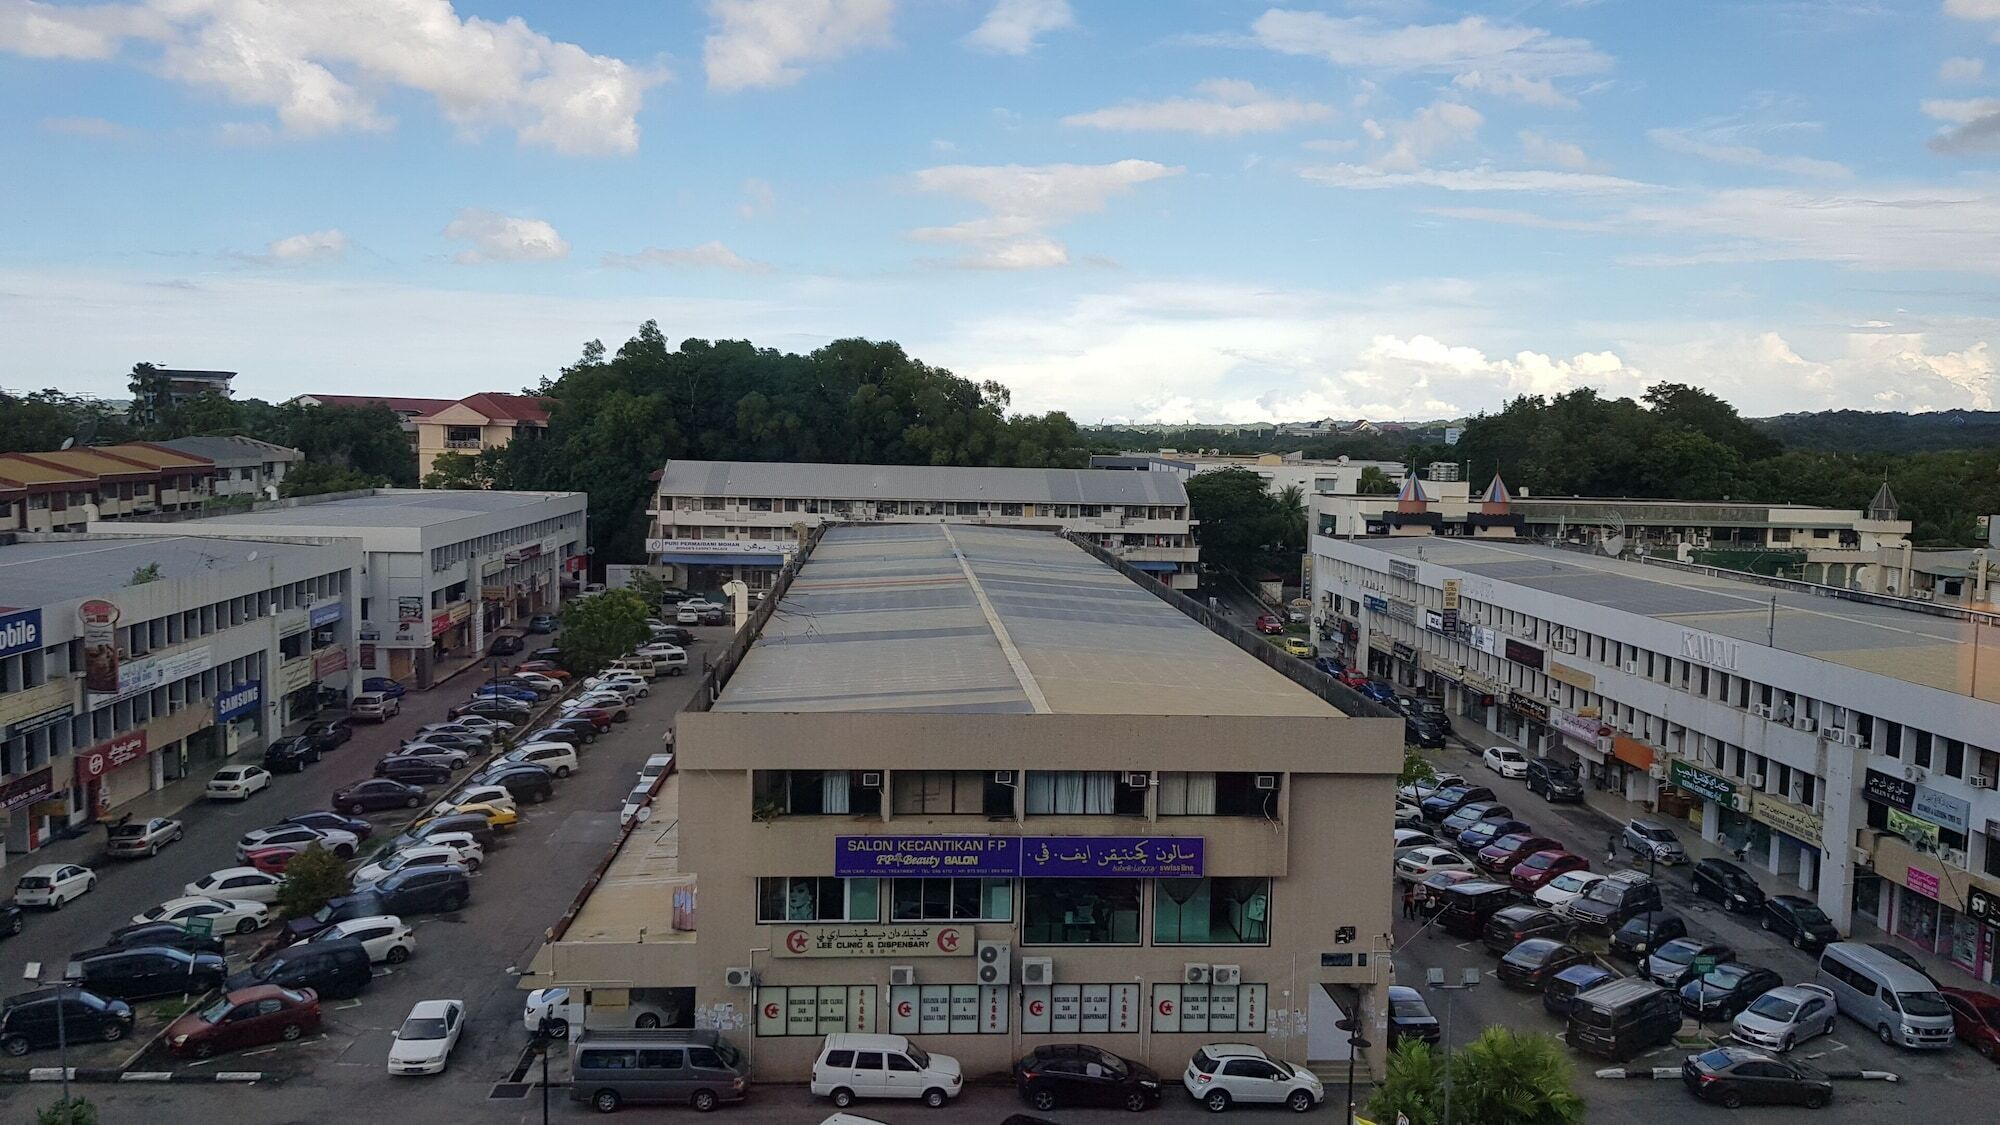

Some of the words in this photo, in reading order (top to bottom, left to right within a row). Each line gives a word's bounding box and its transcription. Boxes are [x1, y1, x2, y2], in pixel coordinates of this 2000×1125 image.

[219, 686, 259, 714] SAMSUNG
[848, 840, 893, 852] SALON
[898, 840, 983, 852] KECANTIKAN
[903, 854, 941, 868] Beauty
[944, 856, 978, 865] SALON
[816, 941, 833, 949] LEE
[836, 941, 863, 949] CLINIC
[867, 941, 874, 949] &
[878, 941, 930, 949] DISPENSARY
